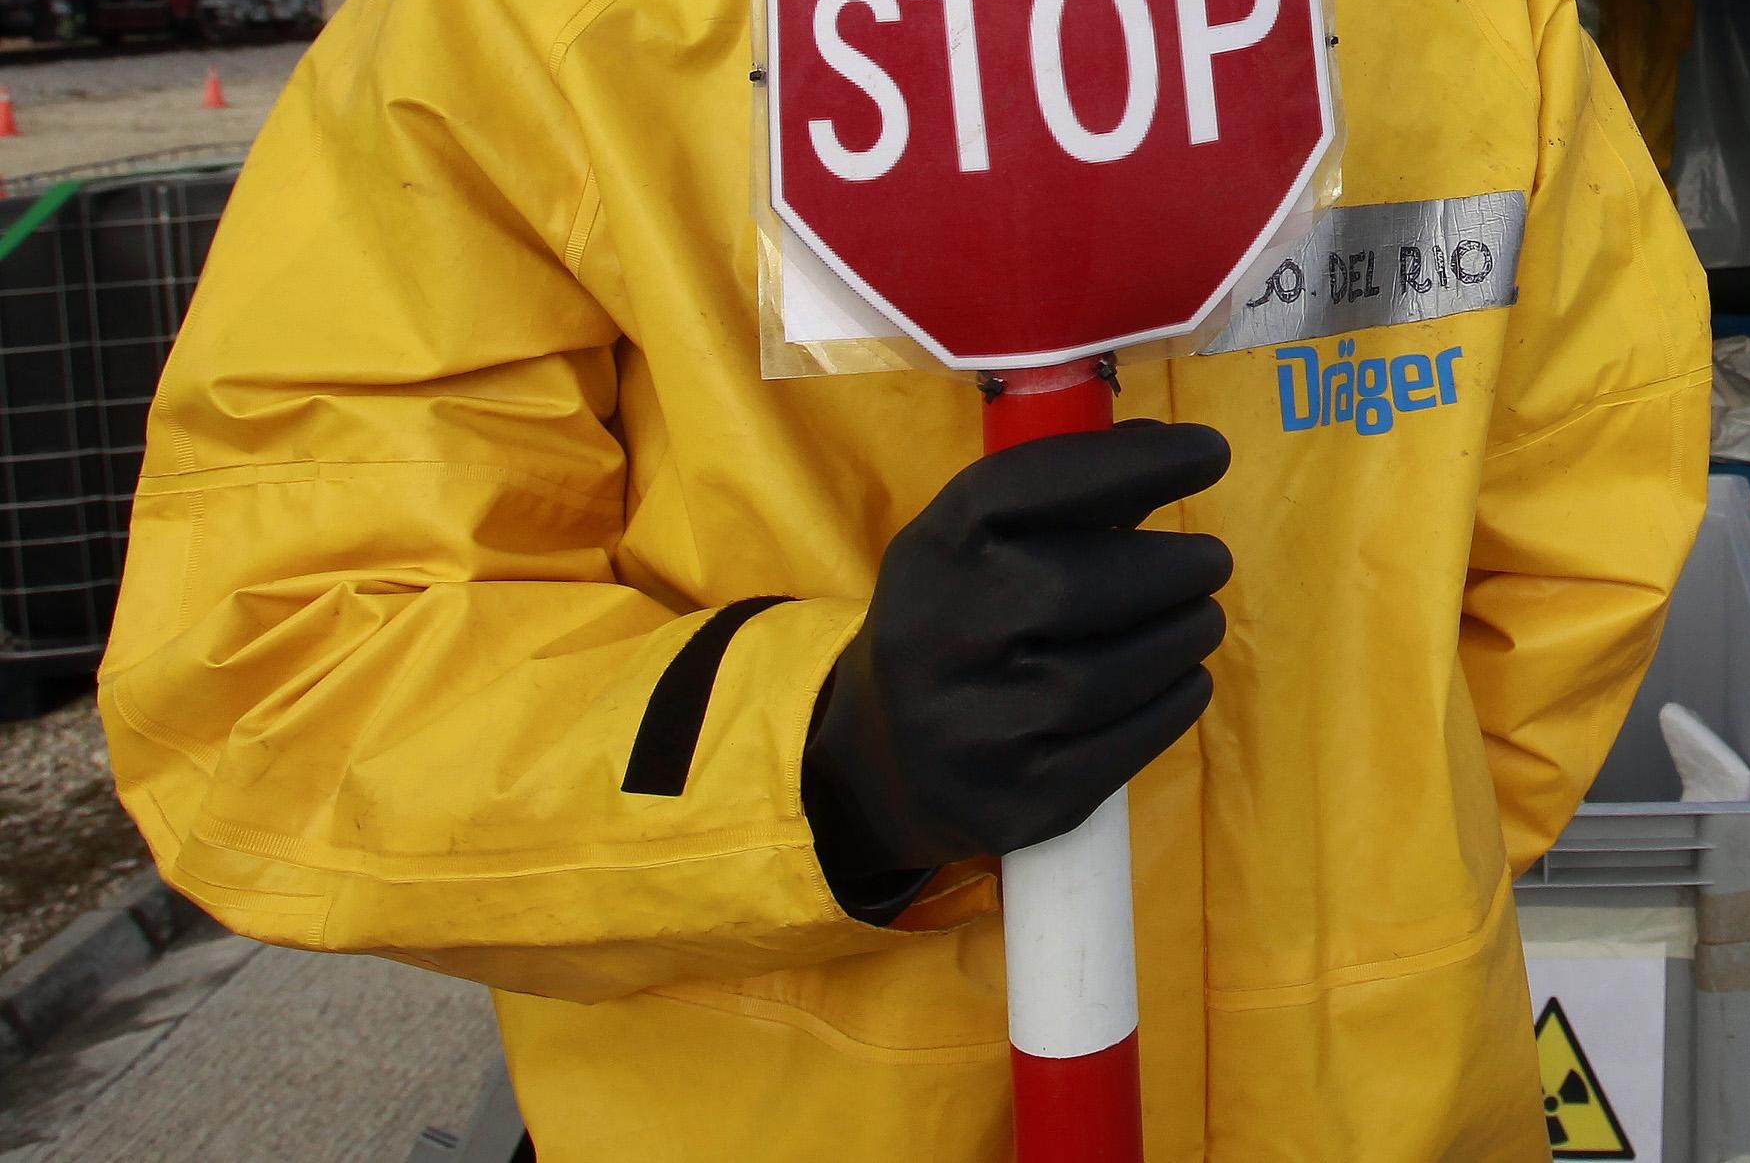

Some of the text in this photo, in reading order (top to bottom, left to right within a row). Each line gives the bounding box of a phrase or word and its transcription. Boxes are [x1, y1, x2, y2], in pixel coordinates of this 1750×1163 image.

[1328, 250, 1380, 305] DEL
[1399, 239, 1494, 294] RIO
[1275, 337, 1463, 436] Dräger
